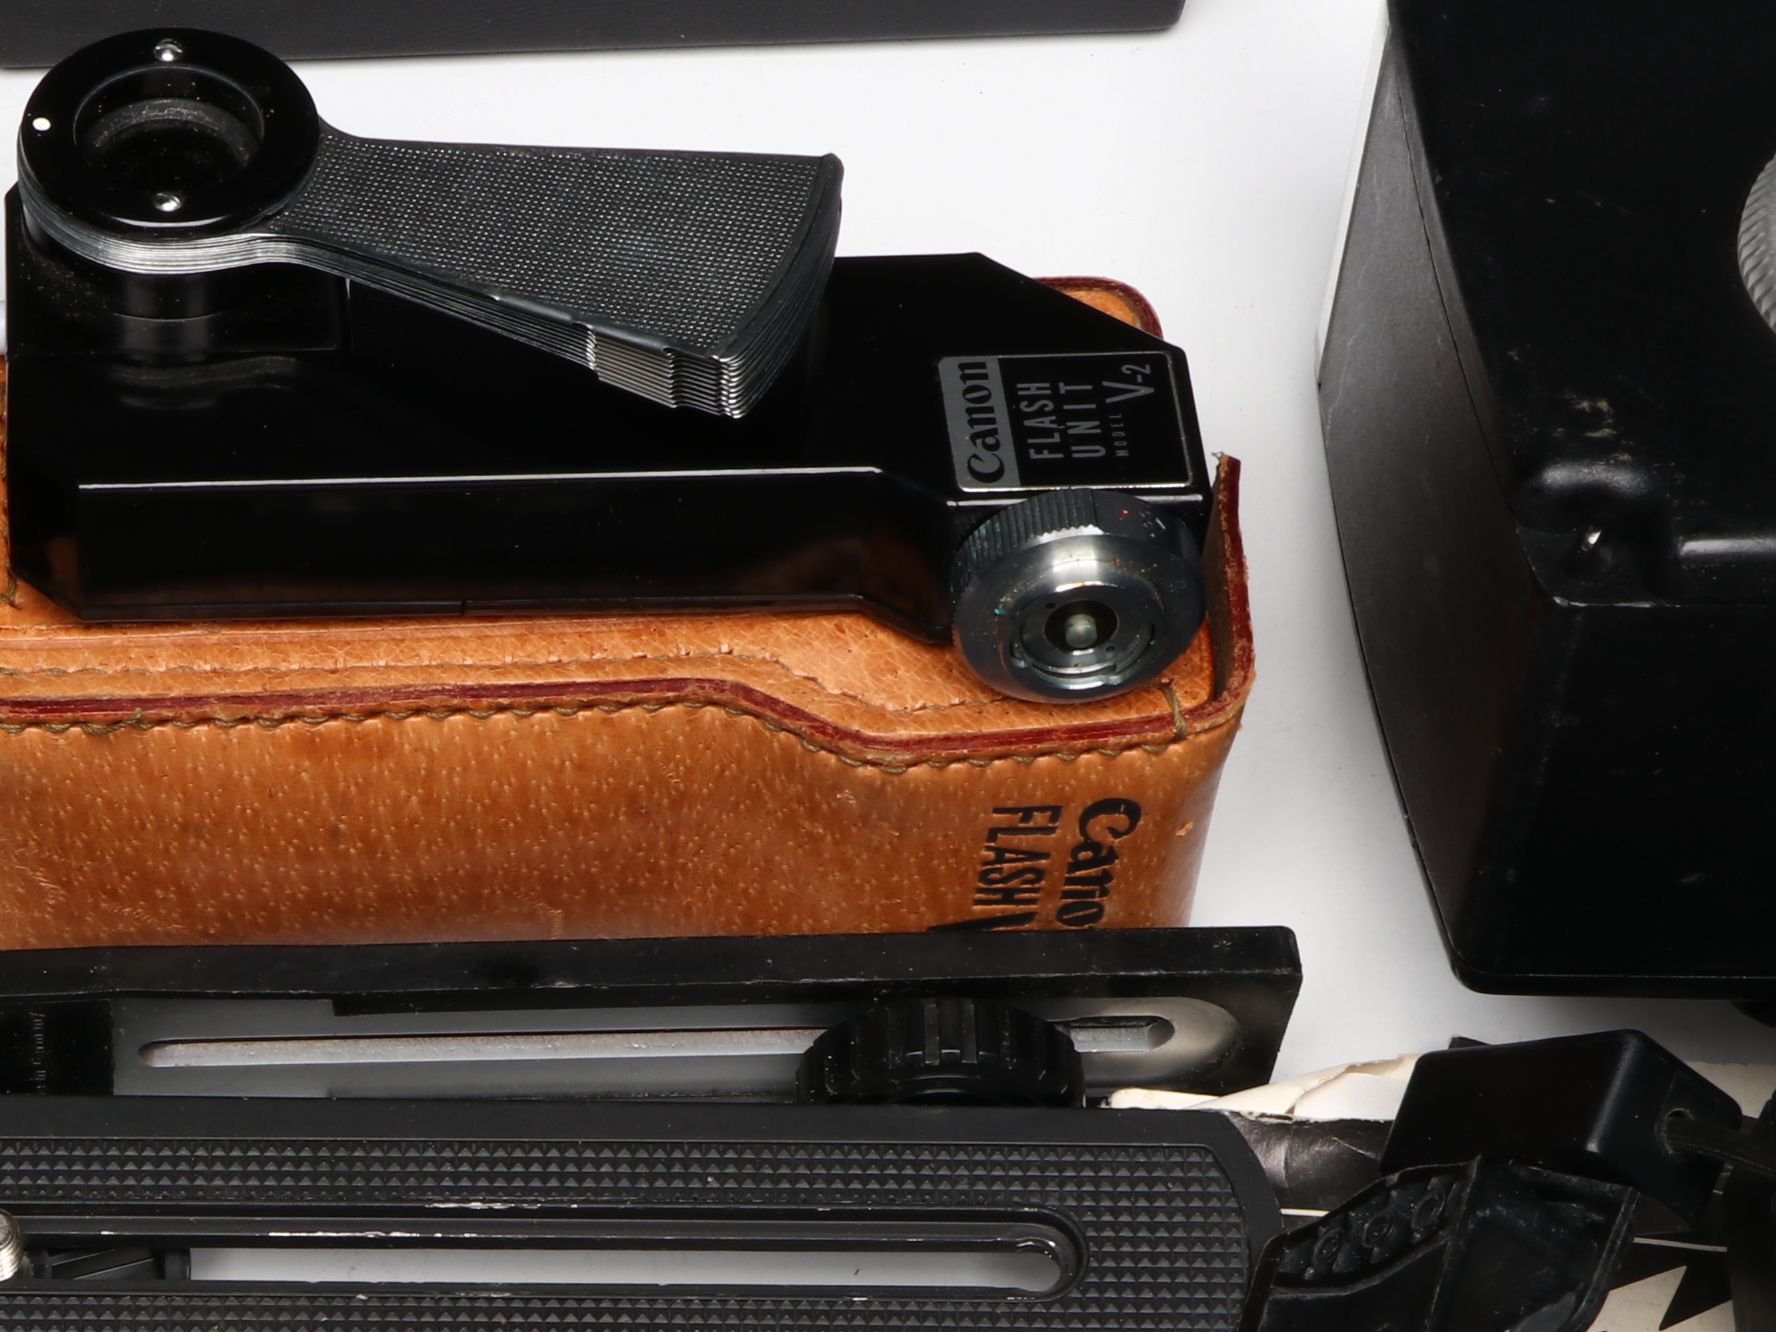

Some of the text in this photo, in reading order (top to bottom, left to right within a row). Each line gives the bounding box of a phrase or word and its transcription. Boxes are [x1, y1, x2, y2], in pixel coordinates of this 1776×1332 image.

[957, 361, 1006, 484] Canon
[1016, 382, 1065, 460] FLASH
[1058, 381, 1106, 459] UNIT
[1102, 363, 1155, 457] MODEL V-2
[973, 804, 1064, 906] FLASH
[1056, 796, 1142, 928] Cano
